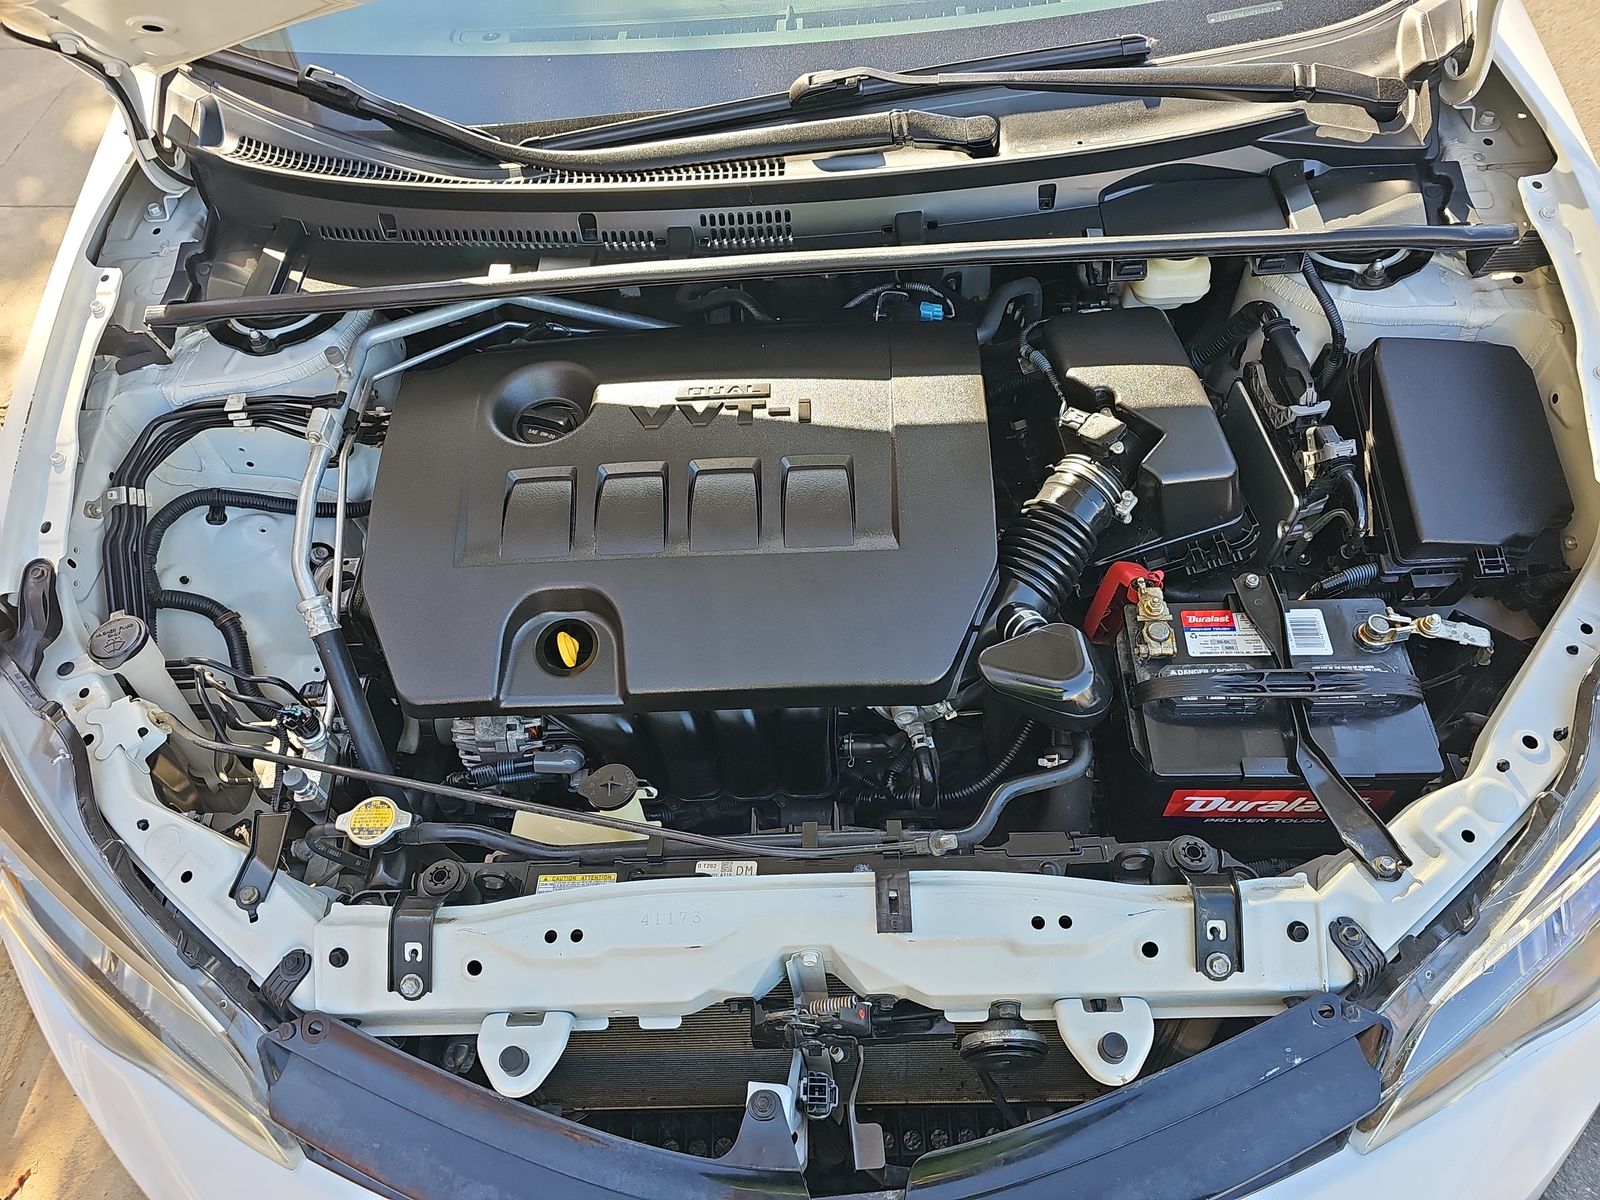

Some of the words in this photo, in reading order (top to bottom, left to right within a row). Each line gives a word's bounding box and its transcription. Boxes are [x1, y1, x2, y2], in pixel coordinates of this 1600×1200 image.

[1186, 615, 1230, 623] Duralast
[736, 865, 753, 876] DM
[640, 911, 702, 926] 41173
